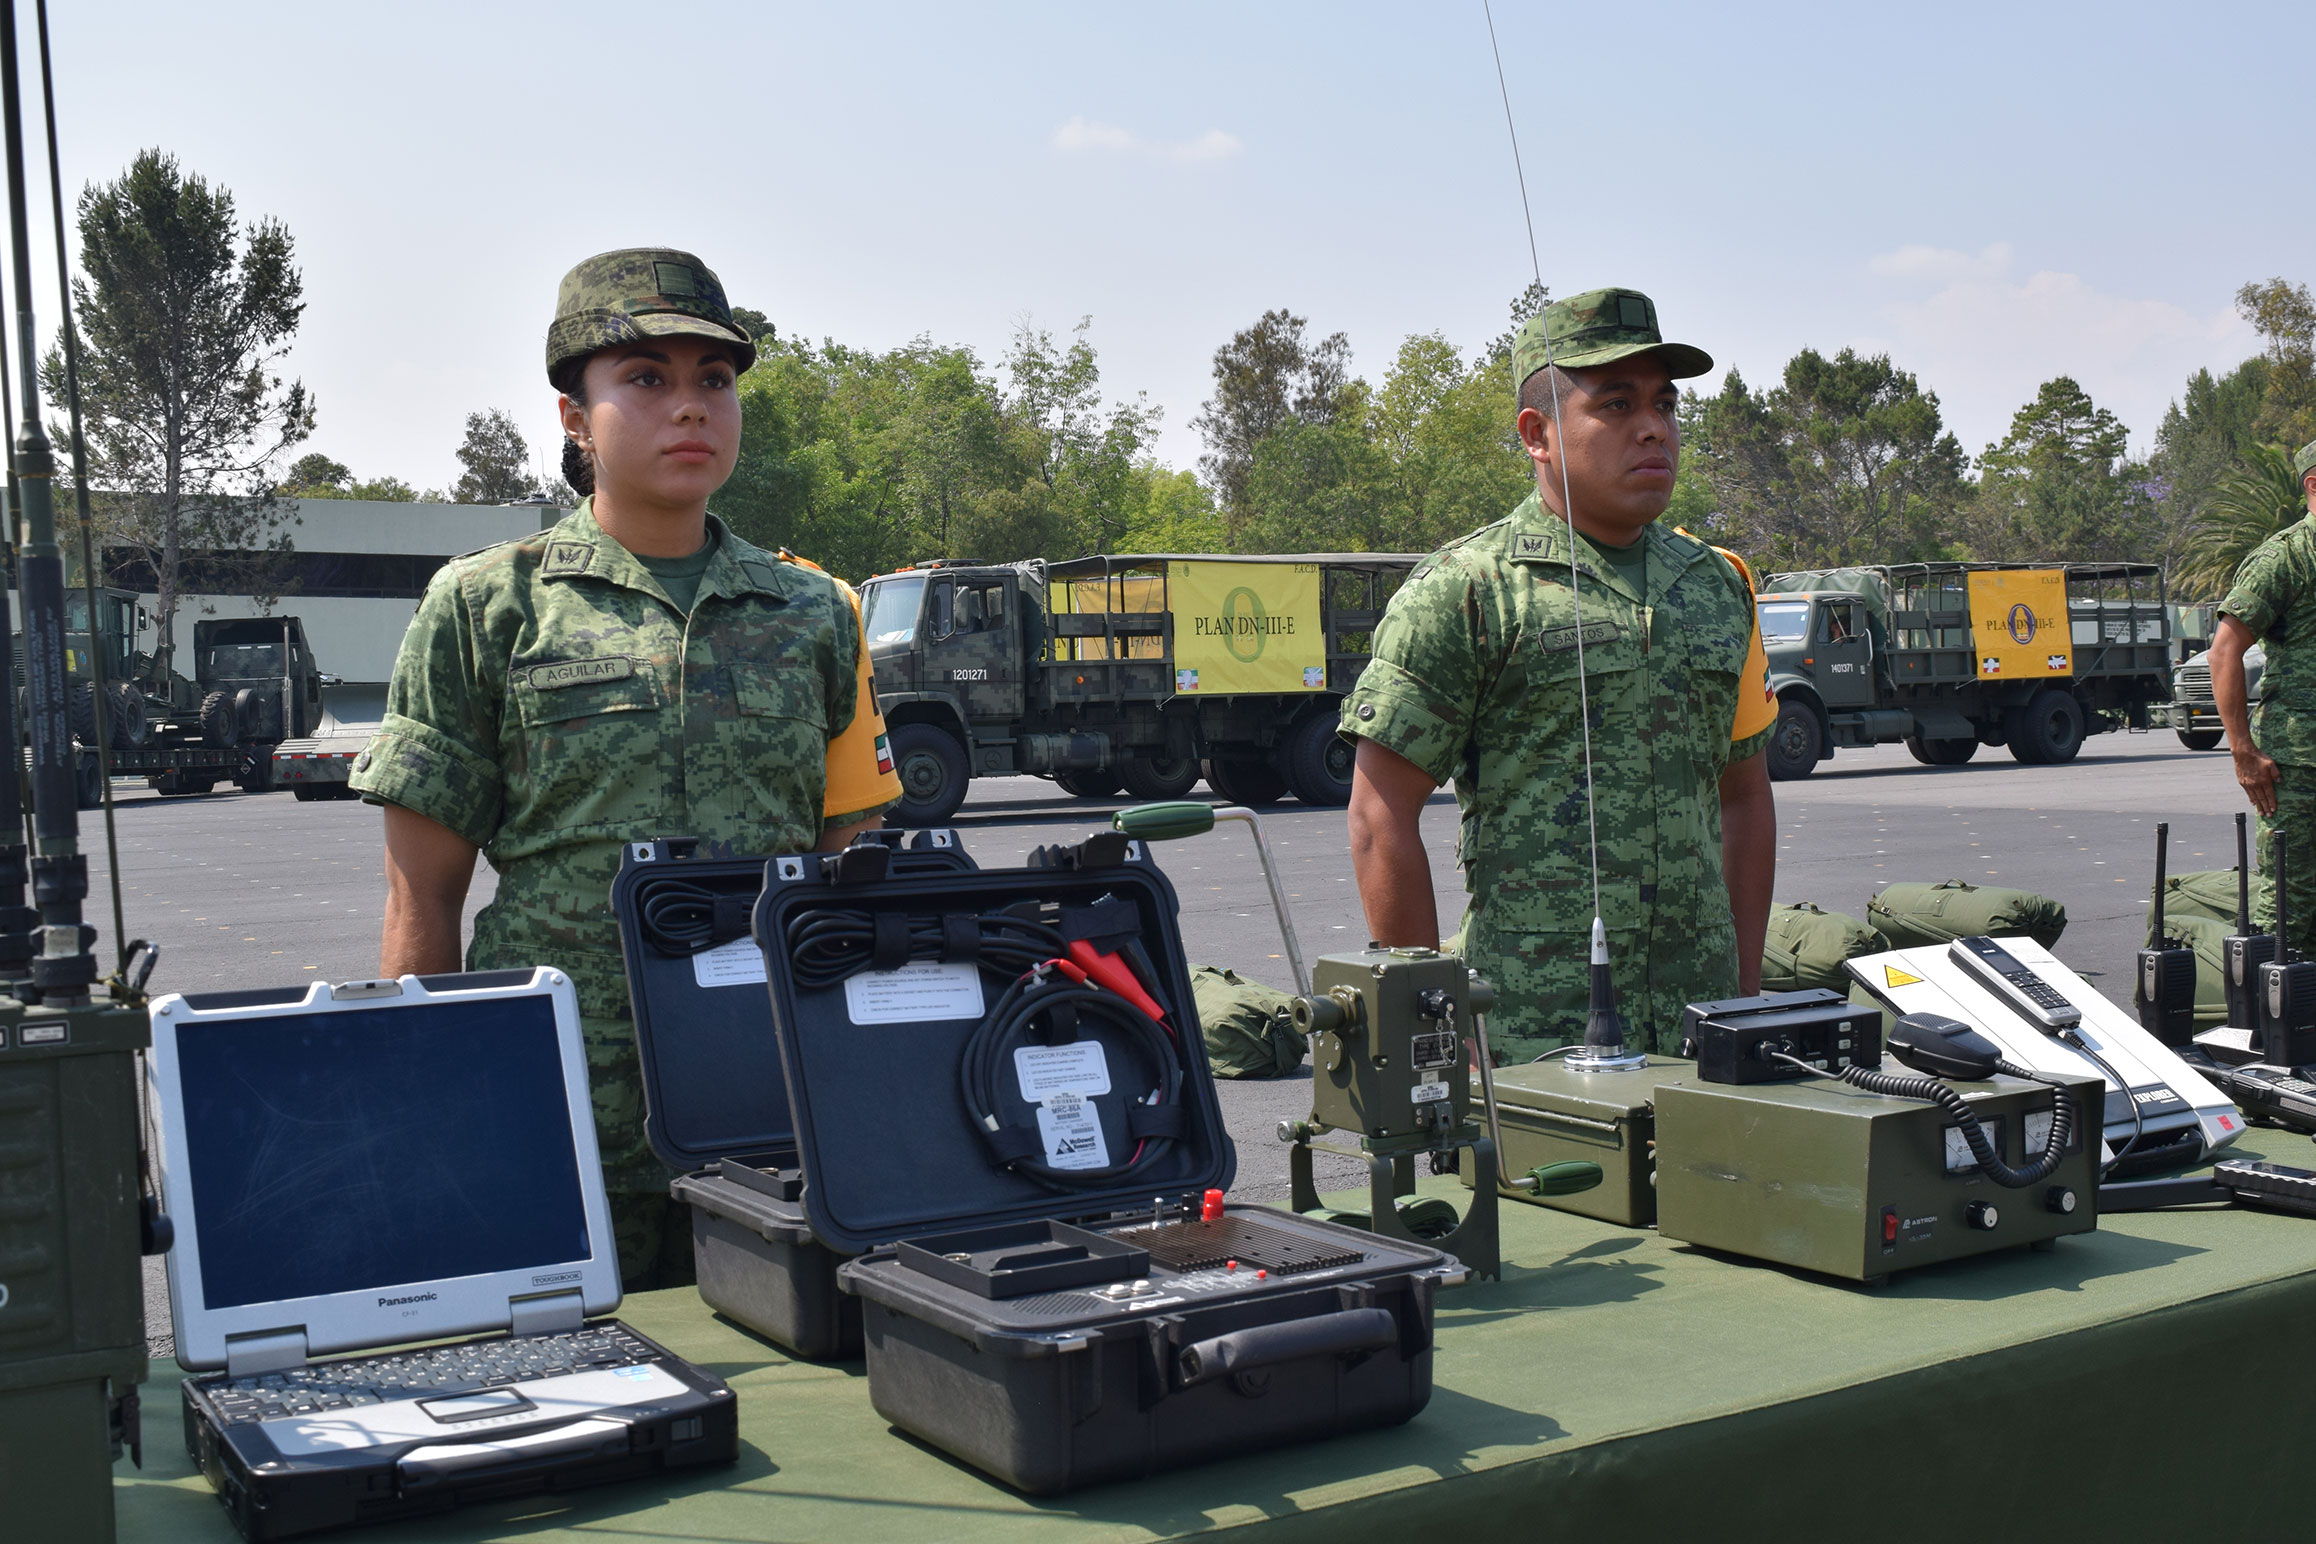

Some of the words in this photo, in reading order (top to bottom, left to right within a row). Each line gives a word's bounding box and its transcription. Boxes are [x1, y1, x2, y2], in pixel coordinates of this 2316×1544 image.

[1194, 616, 1235, 636] PLAN
[1238, 616, 1296, 635] DN-III-E
[1554, 627, 1605, 645] SANTOS
[546, 662, 616, 682] AGUILAR
[952, 669, 987, 680] 1201271
[1027, 1052, 1056, 1060] INDICATOR
[2132, 1088, 2177, 1104] EXPLORER
[1911, 1215, 1938, 1226] ASTRON
[534, 1272, 580, 1285] TOUGHBOOK
[377, 1291, 438, 1308] Panasonic
